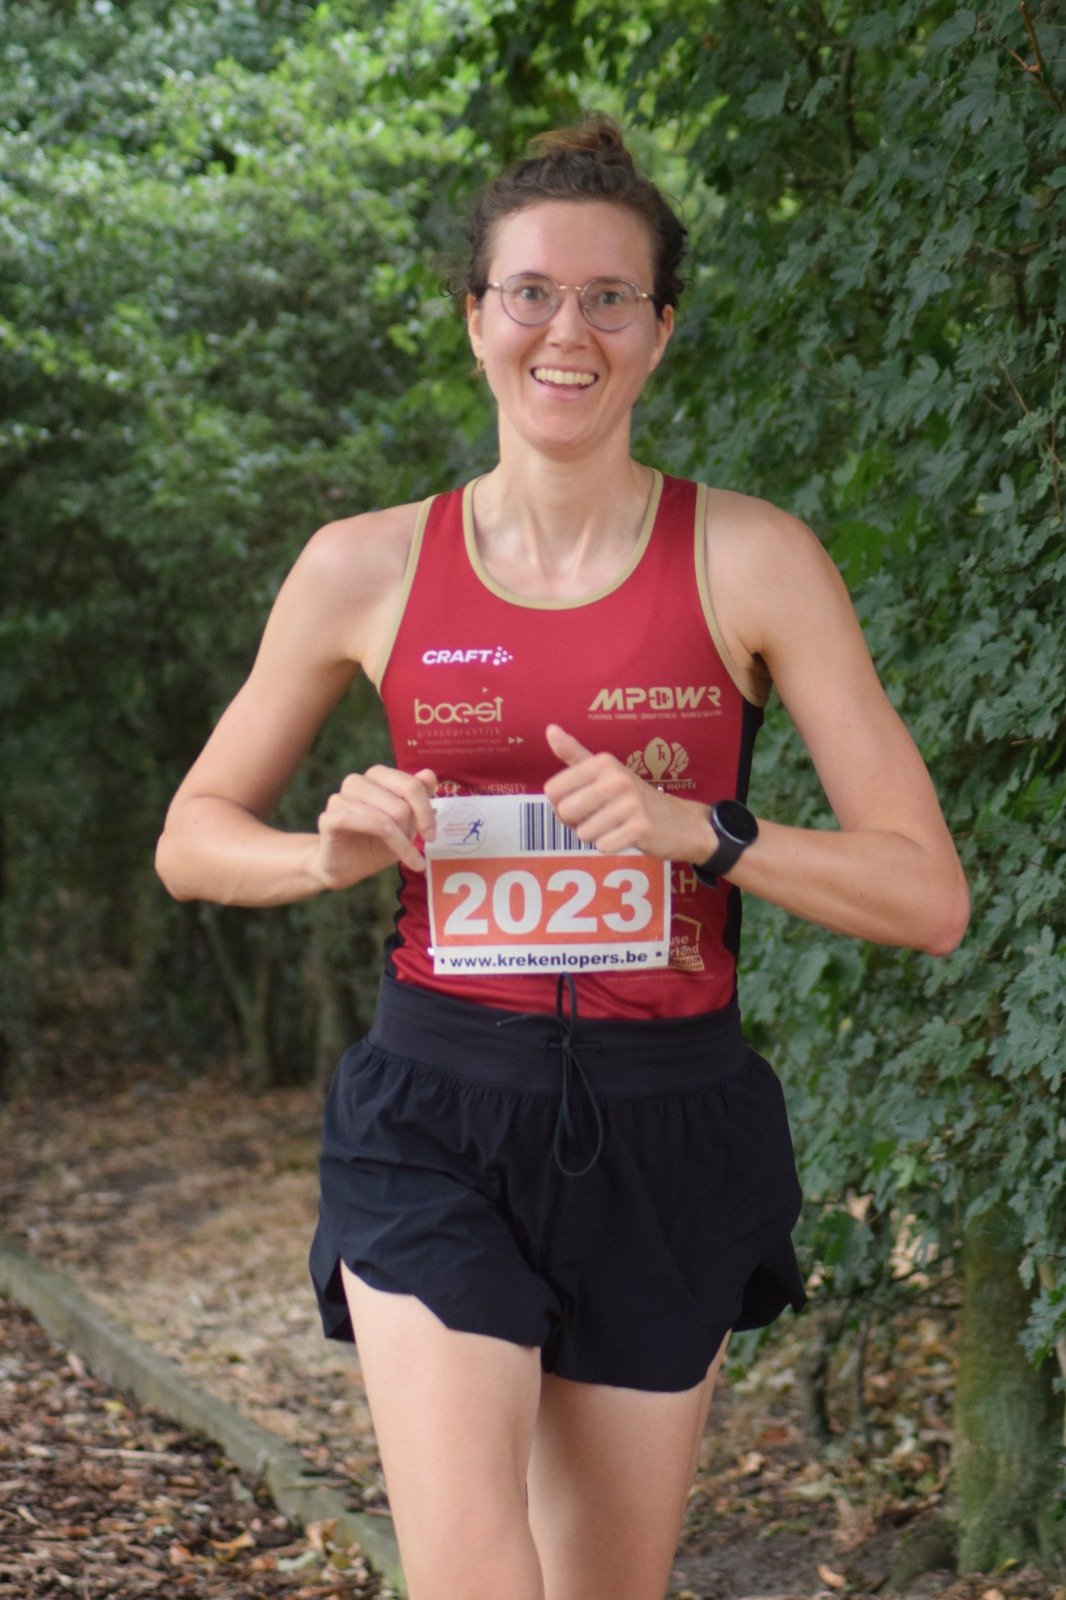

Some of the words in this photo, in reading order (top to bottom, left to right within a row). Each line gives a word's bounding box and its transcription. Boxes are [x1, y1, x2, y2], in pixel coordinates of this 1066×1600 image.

[422, 650, 493, 664] CRAFT
[588, 686, 722, 711] MPOWR
[442, 868, 652, 935] 2023
[450, 950, 648, 968] www.krekenlopers.be
